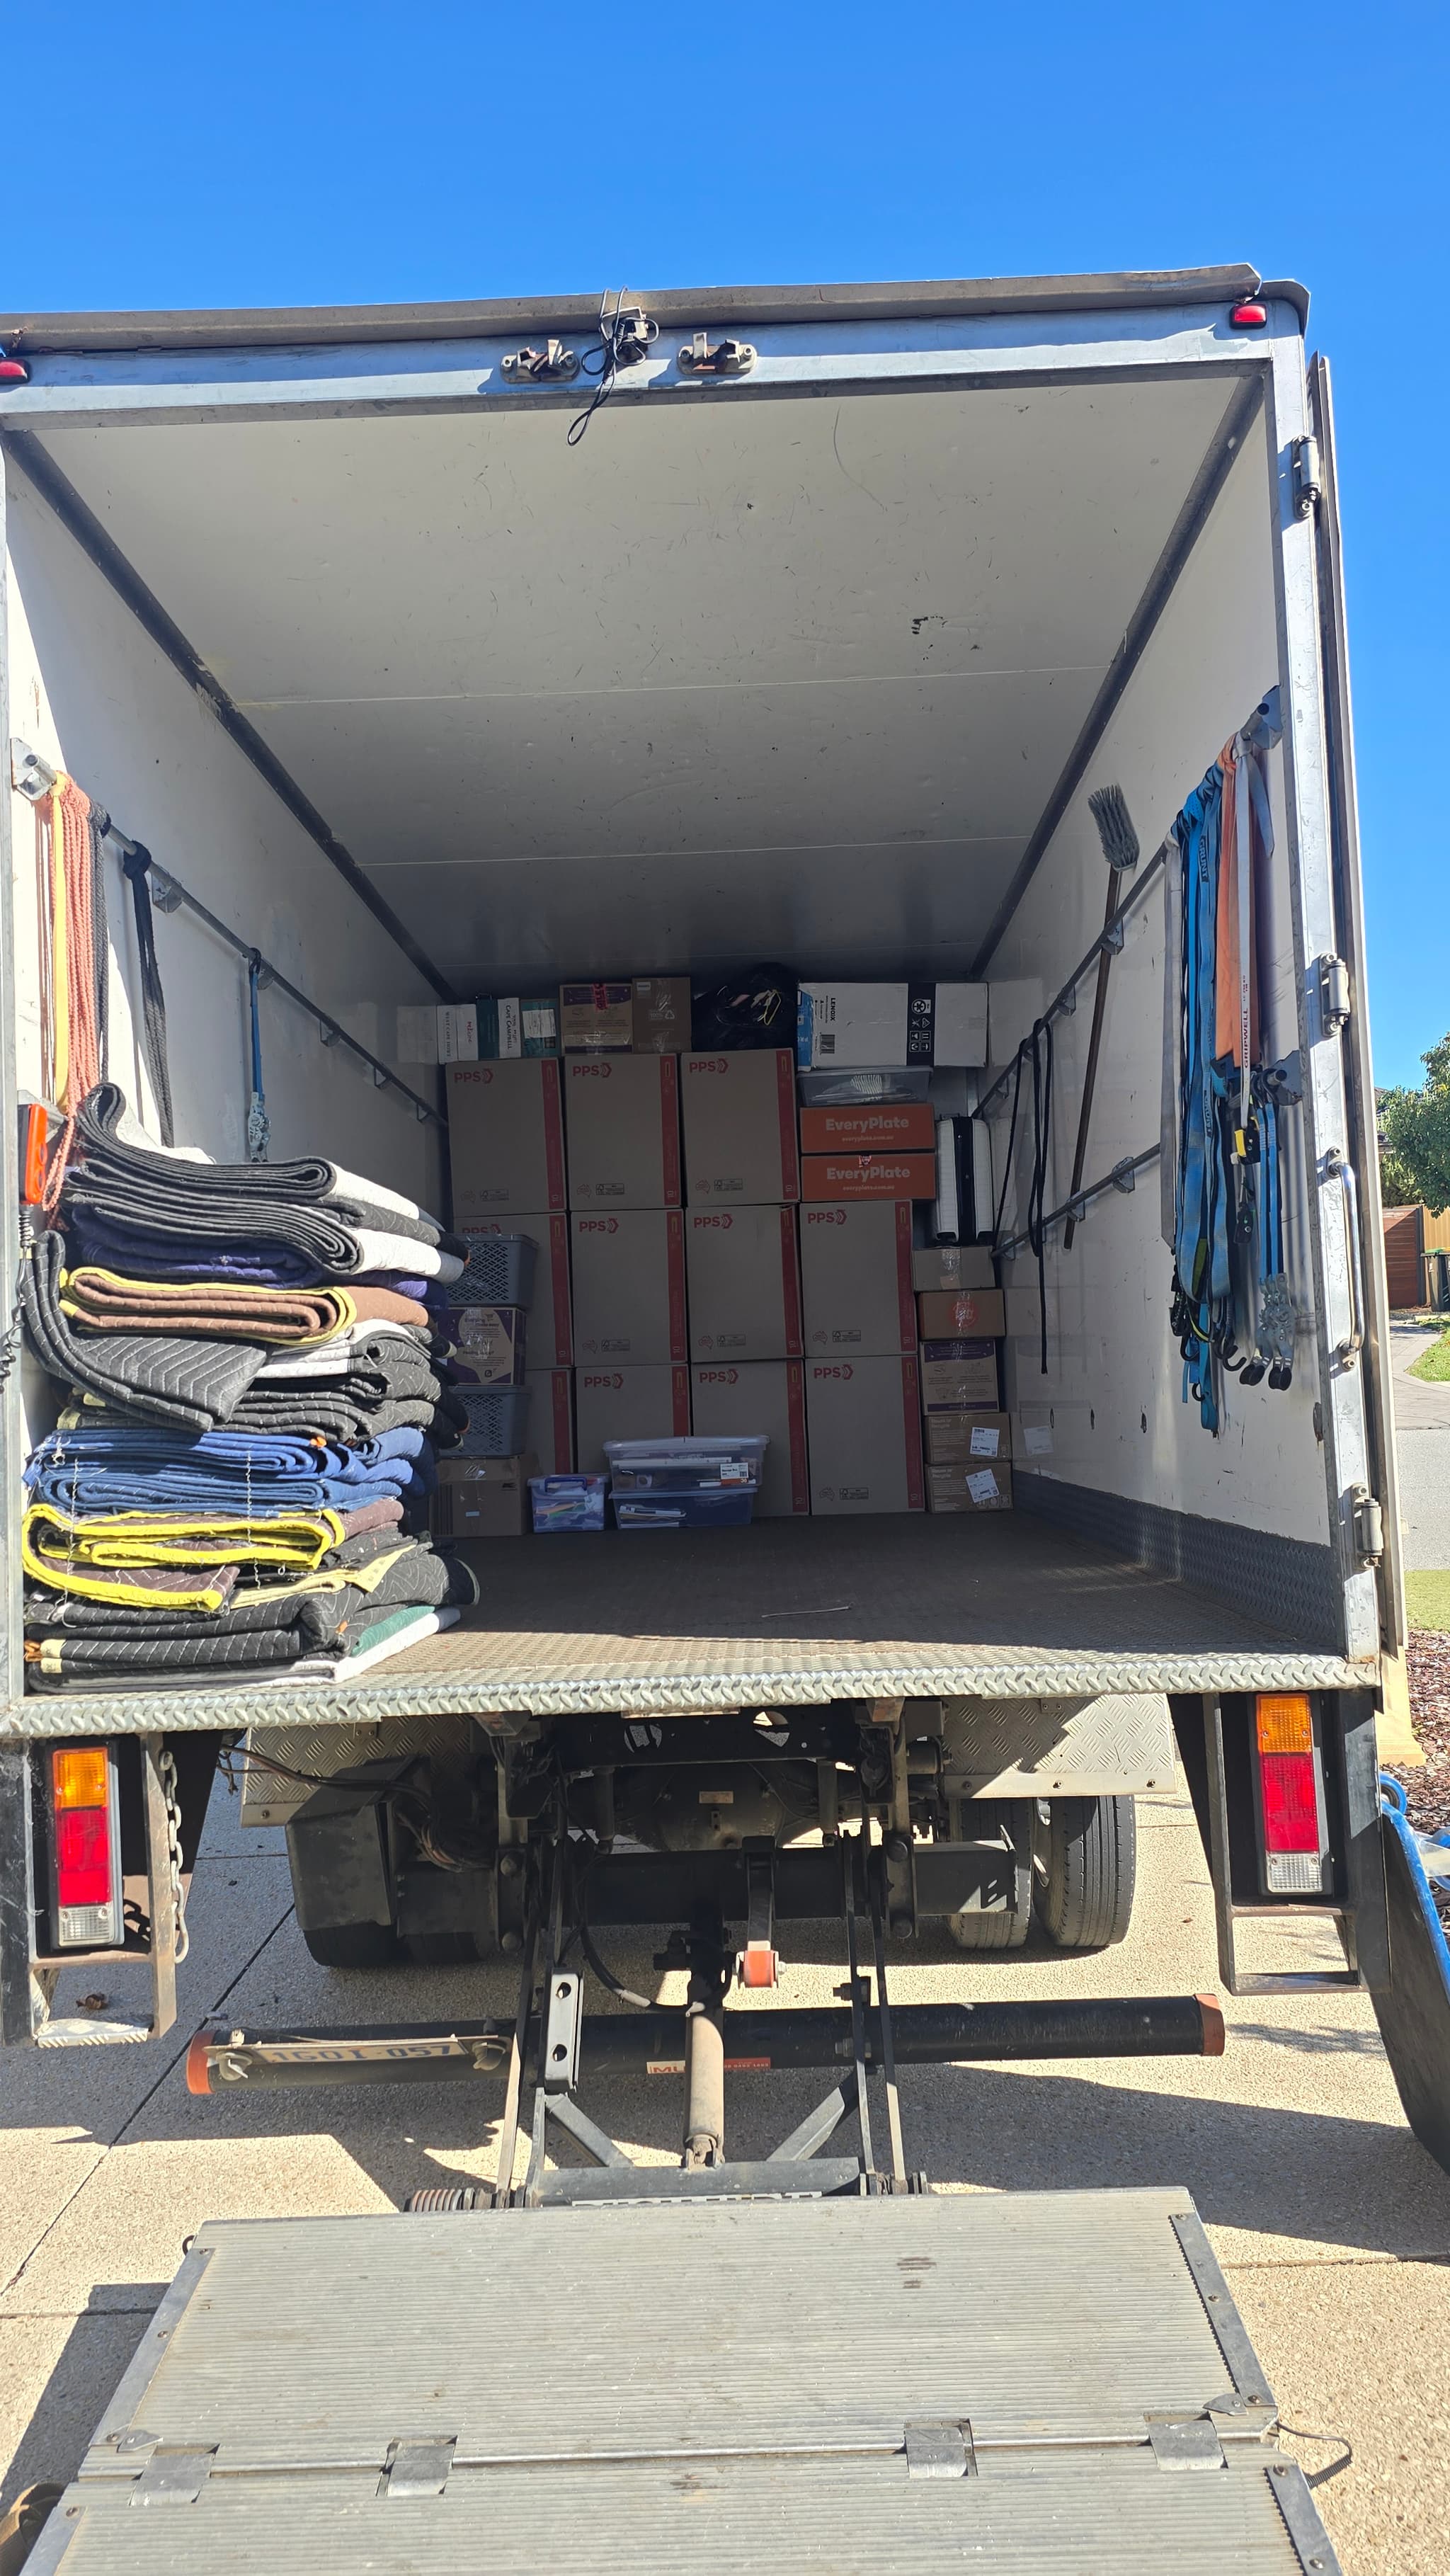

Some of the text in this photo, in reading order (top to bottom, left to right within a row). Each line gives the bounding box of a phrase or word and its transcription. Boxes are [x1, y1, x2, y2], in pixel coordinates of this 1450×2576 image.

[1199, 838, 1208, 878] GRUNT
[573, 1065, 600, 1077] PPS
[689, 1061, 717, 1073] PPS
[454, 1071, 481, 1083] PPS
[825, 1116, 910, 1133] EveryPlate
[826, 1166, 910, 1182] EveryPlate
[693, 1216, 721, 1229] PPS
[807, 1212, 835, 1224] PPS
[578, 1220, 607, 1233] PPS
[700, 1372, 726, 1384] PPS
[814, 1367, 841, 1379] PPS
[584, 1376, 612, 1388] PPS
[386, 2046, 450, 2058] 057
